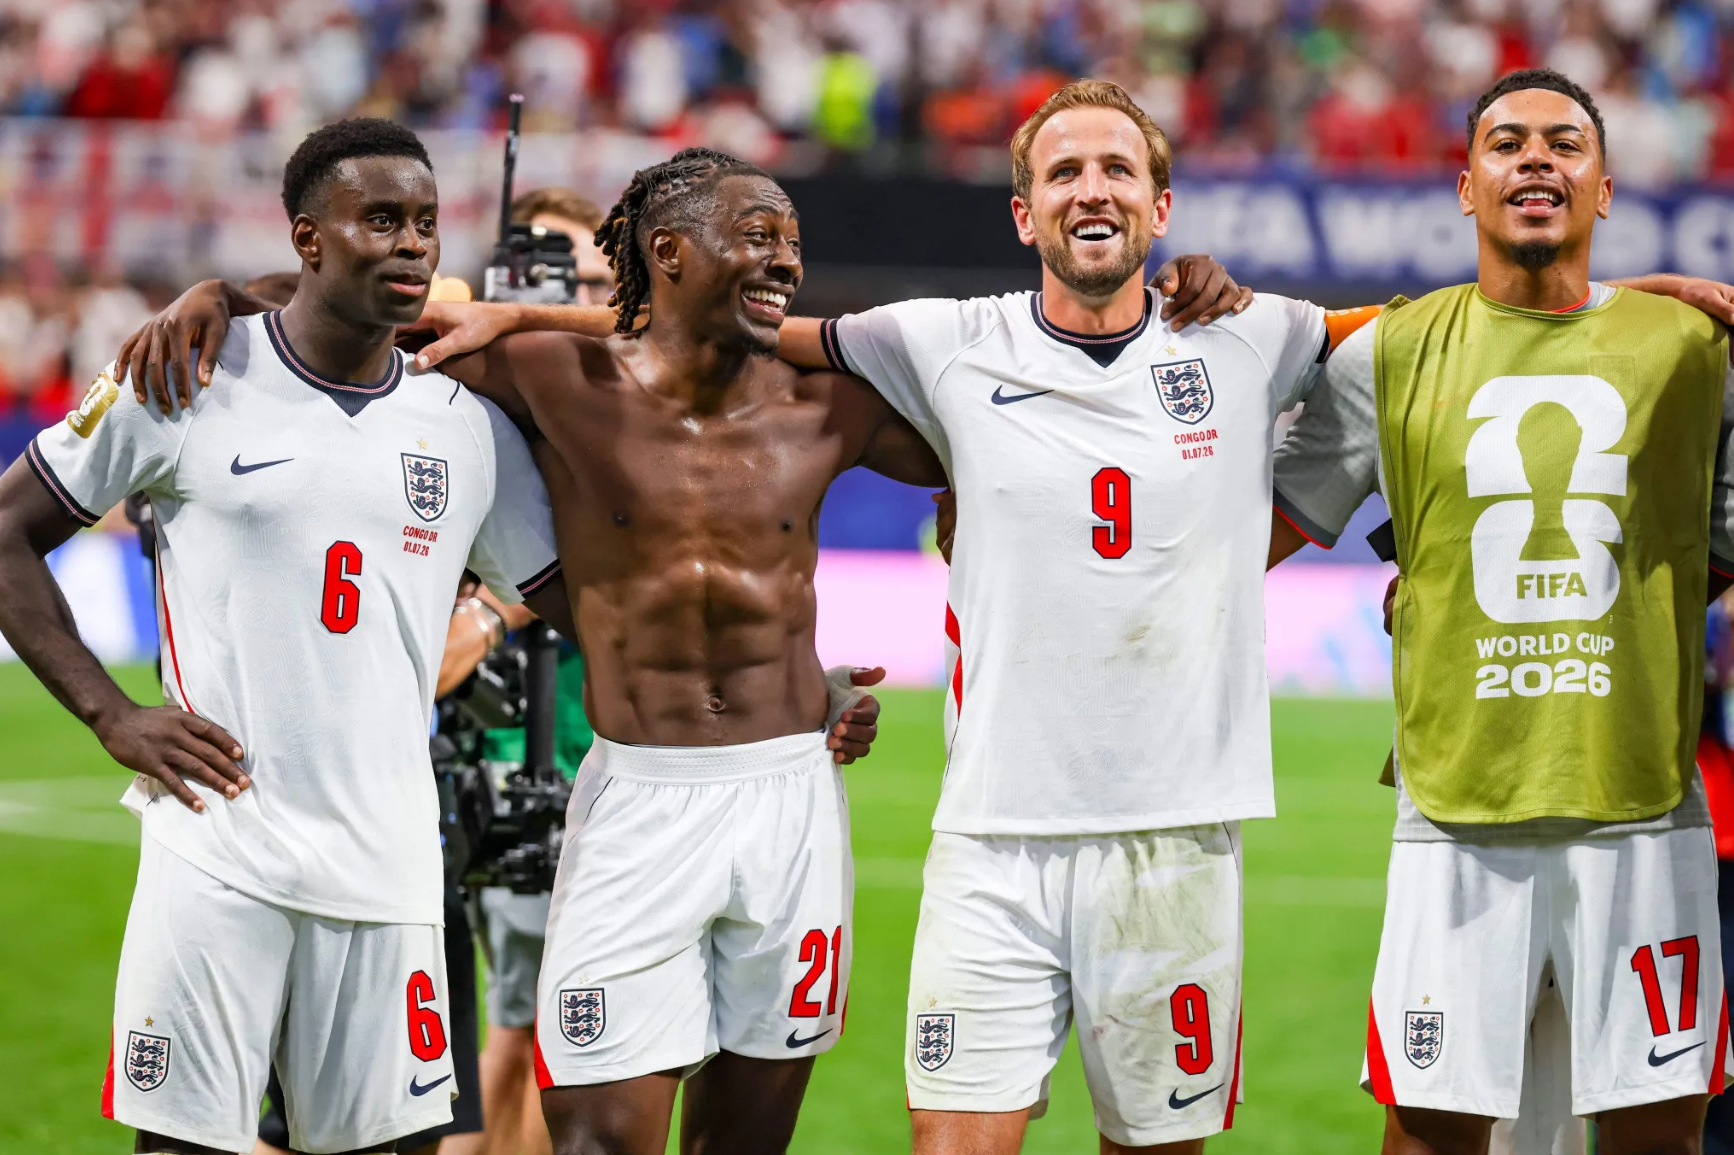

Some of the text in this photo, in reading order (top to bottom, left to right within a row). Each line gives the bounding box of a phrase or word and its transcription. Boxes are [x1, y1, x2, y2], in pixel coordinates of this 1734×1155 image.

[1174, 429, 1218, 445] CONGO DR
[1182, 446, 1214, 460] 01.07.26
[403, 525, 438, 543] CONGO DR
[1091, 467, 1132, 559] 9
[403, 541, 430, 556] 01.07.26
[321, 540, 363, 634] 6
[1516, 572, 1588, 599] FIFA
[1475, 632, 1615, 658] WORLD CUP
[1475, 658, 1612, 700] 2026
[788, 925, 842, 1018] 21
[1630, 935, 1700, 1037] 17
[406, 970, 447, 1062] 6
[1170, 984, 1213, 1075] 9
